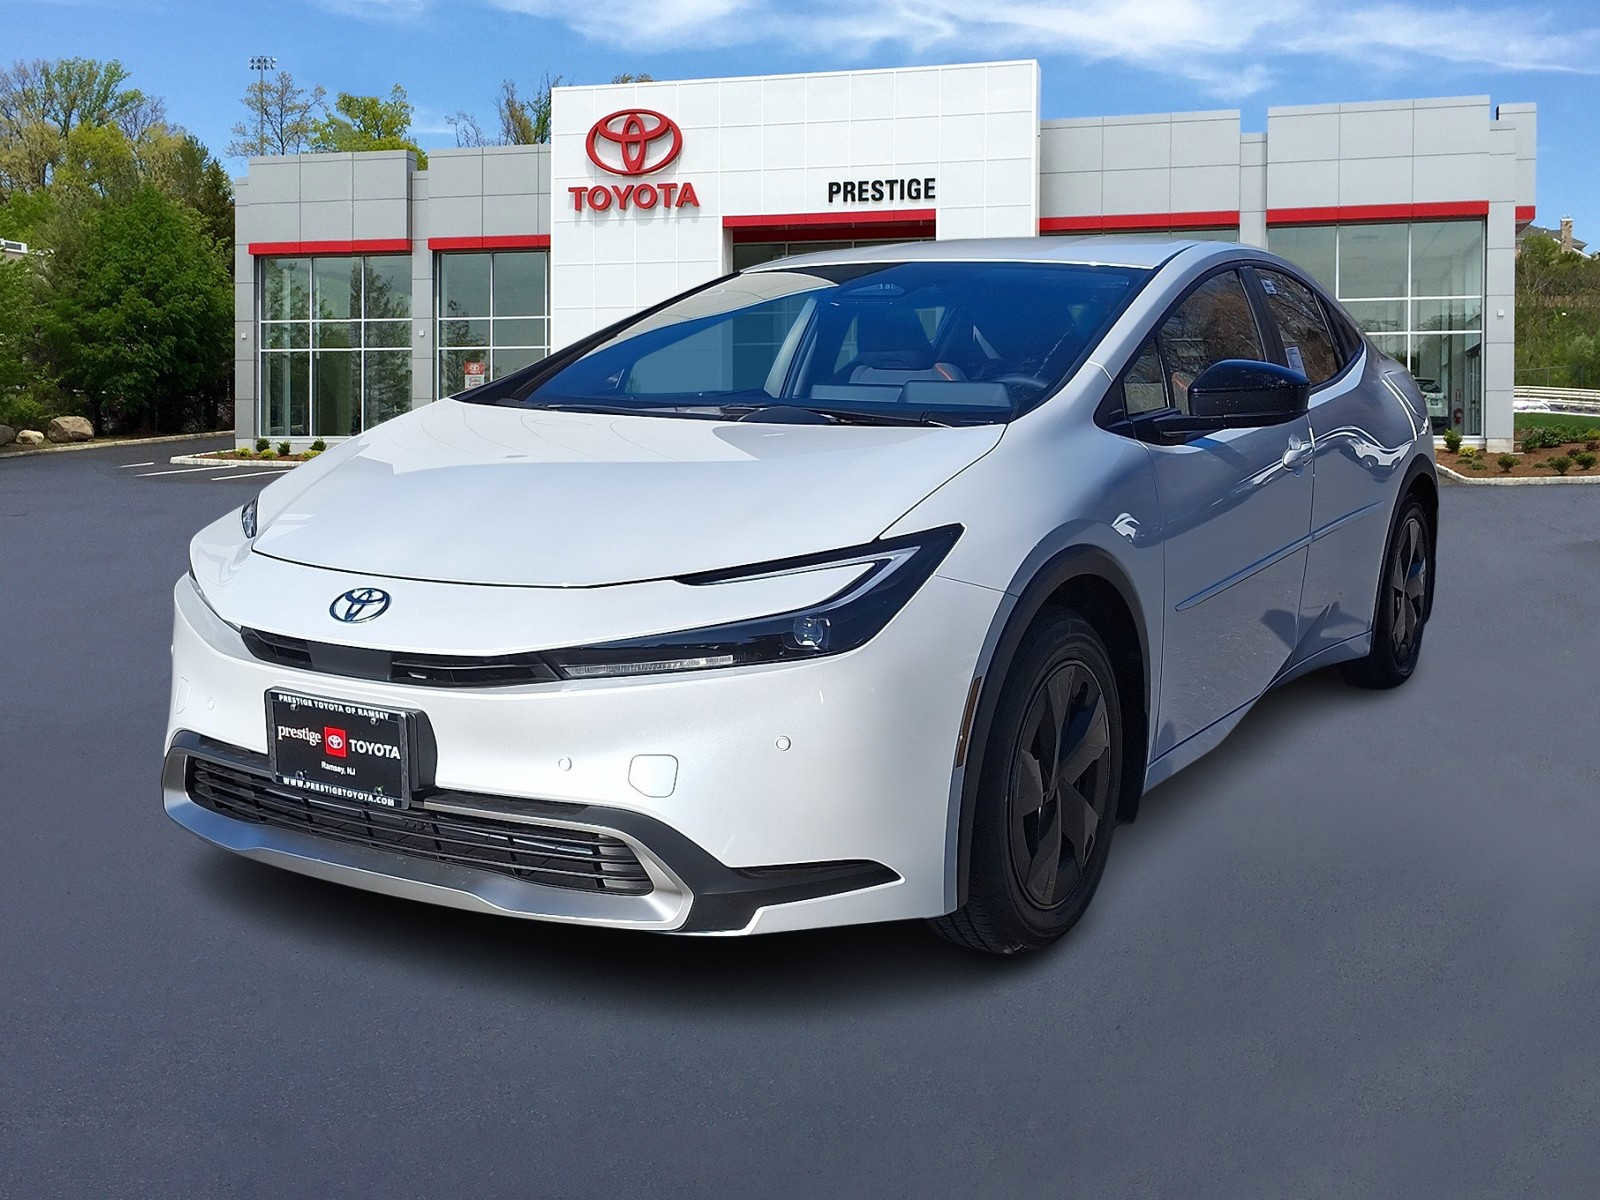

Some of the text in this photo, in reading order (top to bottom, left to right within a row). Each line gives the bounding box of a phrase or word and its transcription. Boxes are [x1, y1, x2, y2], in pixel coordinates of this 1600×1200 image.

[568, 182, 700, 212] TOYOTA
[828, 178, 936, 203] PRESTIGE
[279, 694, 389, 720] PRESTIGE TOYOTA OF RAMSEY
[278, 726, 400, 760] prestige TOYOTA
[321, 761, 345, 775] Ramsey,
[283, 777, 394, 807] WWW.PRESTIGETOYOTA.COM
